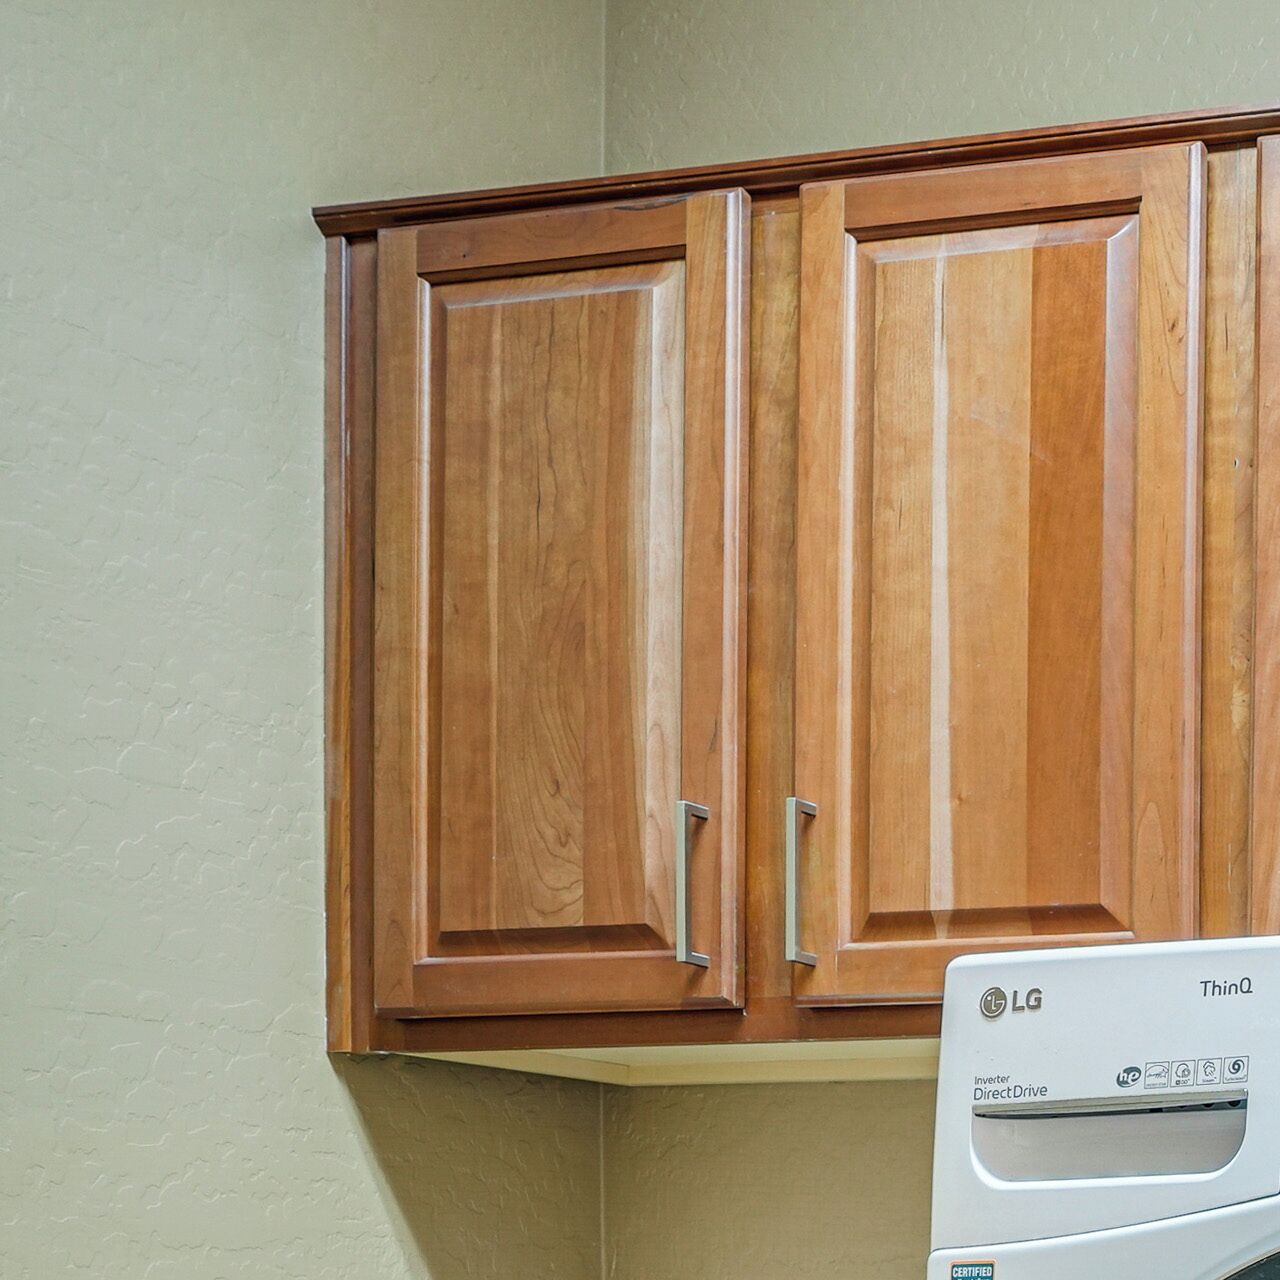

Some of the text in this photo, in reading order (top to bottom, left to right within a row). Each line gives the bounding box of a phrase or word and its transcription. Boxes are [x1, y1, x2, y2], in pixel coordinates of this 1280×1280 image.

[1200, 977, 1253, 997] ThinQ
[1011, 988, 1043, 1012] LG
[974, 1074, 1010, 1085] Inverter
[952, 1266, 992, 1277] CERTIFIED
